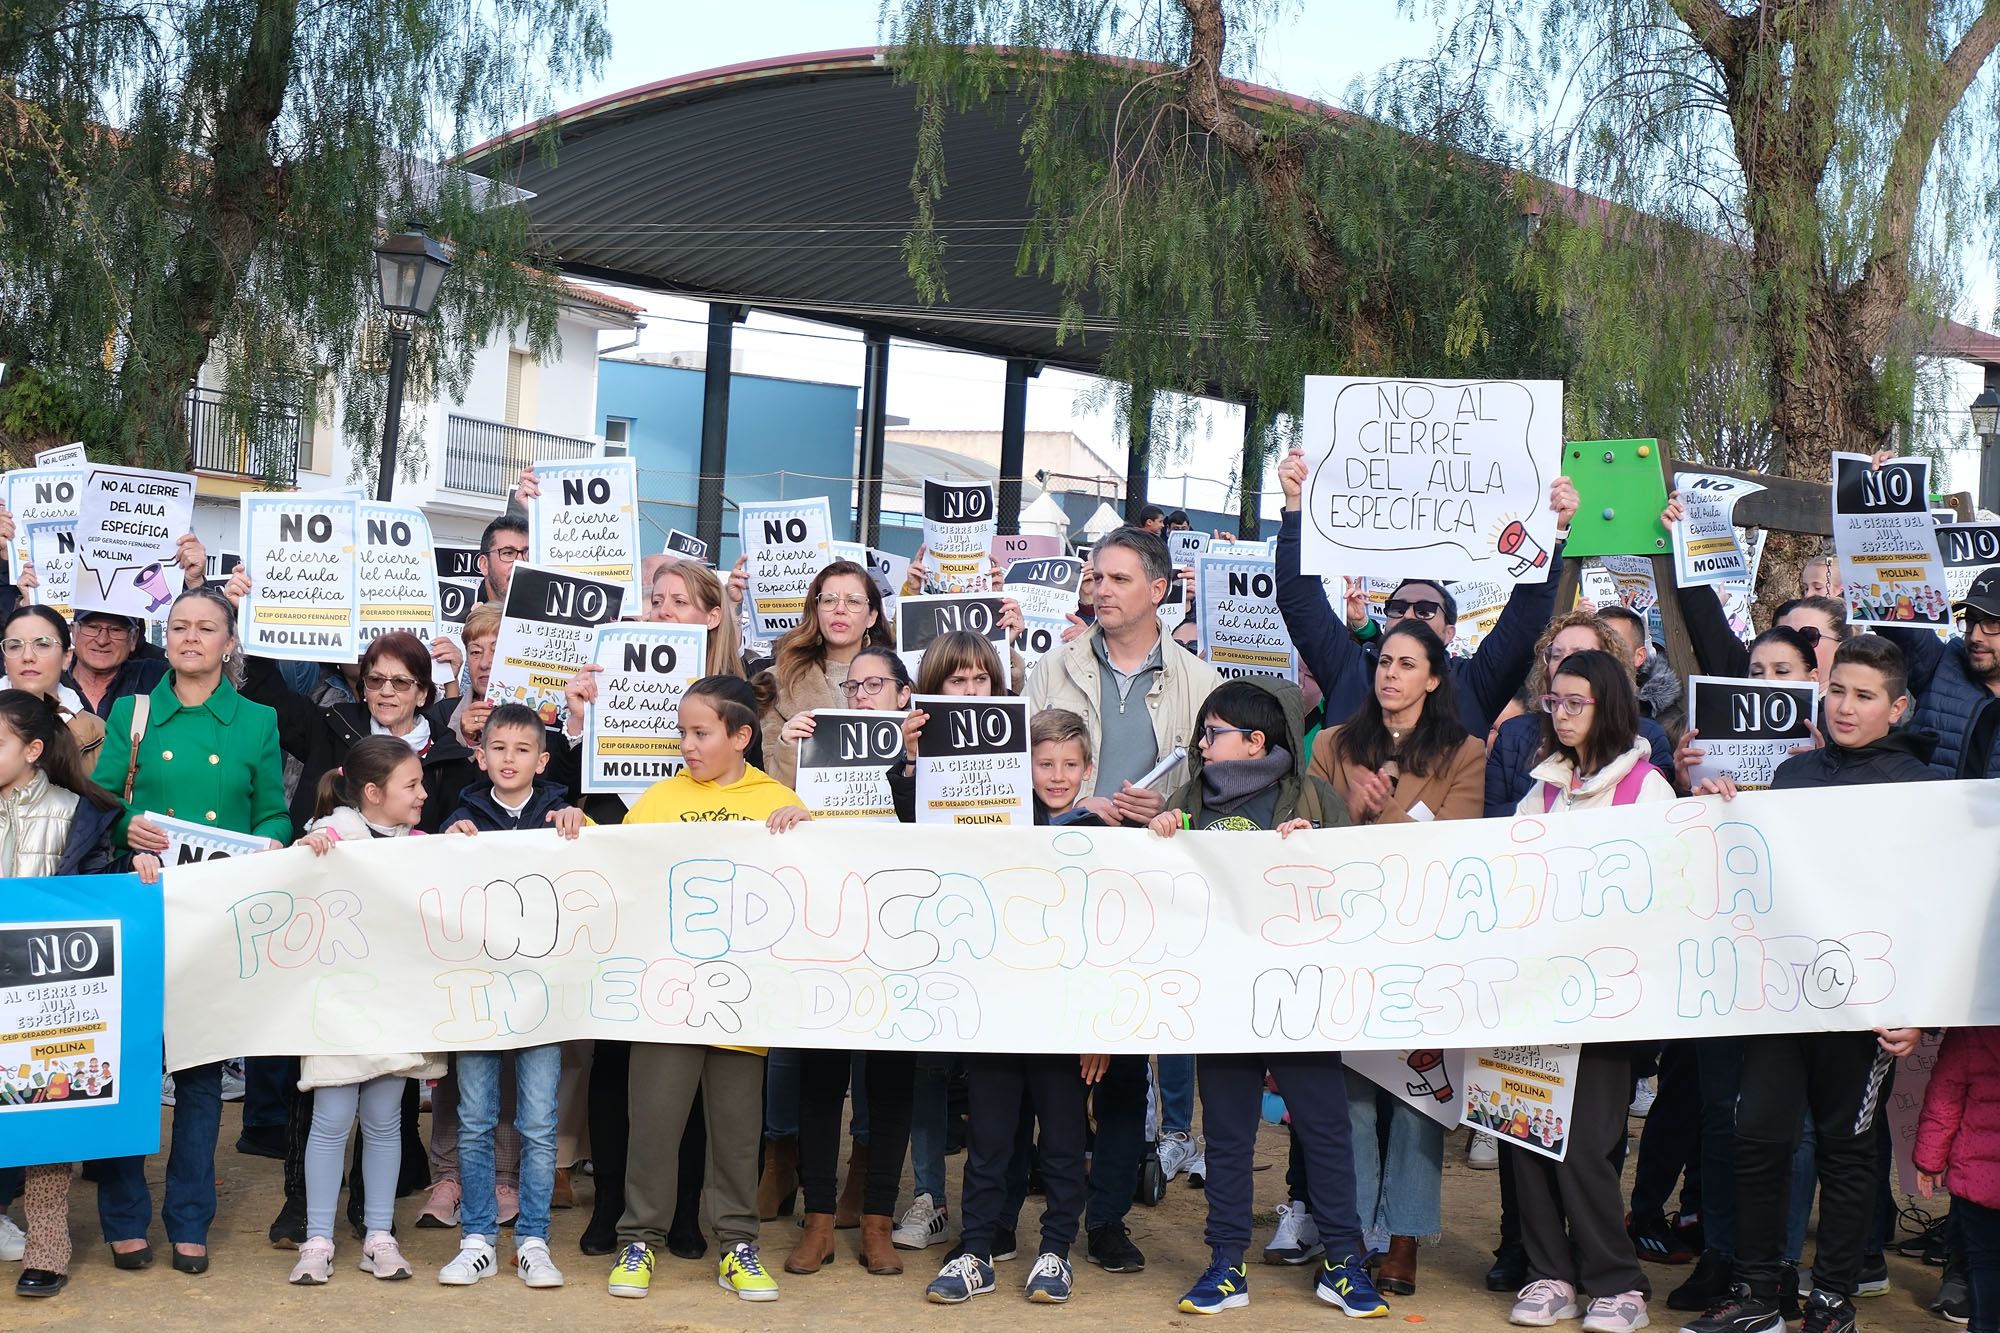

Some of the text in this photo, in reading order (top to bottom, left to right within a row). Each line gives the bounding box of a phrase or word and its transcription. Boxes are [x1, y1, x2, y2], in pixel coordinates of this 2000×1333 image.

[1378, 386, 1498, 422] NO AL
[1358, 420, 1472, 456] CIERRE
[52, 456, 58, 464] AL
[58, 452, 78, 463] CIERRE
[1346, 458, 1504, 494] DEL AULA
[101, 480, 180, 498] NO AL CIERRE
[562, 478, 610, 506] NO
[1692, 479, 1734, 491] NO
[1862, 466, 1912, 506] NO
[35, 482, 74, 504] NO
[1697, 494, 1724, 503] cierre
[110, 501, 165, 516] DEL AULA
[944, 489, 986, 518] NO
[22, 507, 78, 518] Al cierre
[553, 512, 620, 525] Al cierre
[1331, 492, 1476, 534] ESPECÍFICA
[101, 520, 169, 538] ESPECÍFICA
[280, 514, 332, 543] NO
[940, 524, 988, 535] CIERRE DEL
[1849, 516, 1924, 529] AL CIERRE DEL
[367, 519, 412, 546] NO
[553, 525, 620, 541] del Aula
[764, 518, 807, 544] NO
[1876, 529, 1902, 540] AULA
[102, 537, 128, 546] GERARDO
[128, 539, 160, 550] FERNÁNDEZ
[680, 537, 701, 554] NO
[947, 535, 970, 544] AULA
[1006, 540, 1028, 551] NO
[1182, 538, 1200, 550] NO
[1862, 540, 1924, 552] ESPECÍFICA
[1950, 530, 1999, 562] NO
[92, 549, 132, 562] MOLLINA
[266, 548, 340, 564] Al cierre
[378, 554, 420, 565] cierre
[550, 546, 626, 562] Específica
[757, 549, 816, 562] Al cierre
[1867, 554, 1894, 562] GERARDO
[46, 561, 62, 570] Al
[759, 562, 818, 578] del Aula
[942, 564, 975, 572] MOLLINA
[1694, 556, 1740, 572] MOLLINA
[49, 572, 70, 584] del
[266, 567, 338, 582] del Aula
[384, 568, 421, 581] Aula
[1028, 561, 1072, 584] NO
[1881, 570, 1919, 578] MOLLINA
[1229, 572, 1273, 598] NO
[1454, 584, 1466, 594] AL
[1600, 588, 1612, 596] DEL
[262, 586, 344, 604] Específica
[546, 580, 608, 622] NO
[1021, 586, 1052, 598] CIERRE
[1054, 592, 1070, 602] DEL
[1026, 594, 1048, 606] AULA
[396, 608, 432, 616] FERNÁNDEZ
[1160, 606, 1177, 615] DEL
[1218, 601, 1280, 614] Al cierre
[274, 612, 307, 620] GERARDO
[308, 612, 348, 621] FERNÁNDEZ
[934, 602, 992, 637] NO
[1218, 614, 1279, 630] del Aula
[259, 630, 343, 646] MOLLINA
[516, 624, 532, 635] AL
[536, 625, 580, 640] CIERRE
[544, 639, 576, 652] AULA
[1216, 632, 1284, 648] Específica
[623, 643, 678, 674] NO
[1228, 652, 1254, 660] GERARDO
[1254, 654, 1288, 662] FERNÁNDEZ
[524, 660, 556, 670] GERARDO
[609, 678, 684, 694] Al cierre
[609, 695, 679, 712] del Aula
[1732, 692, 1798, 732] NO
[949, 708, 1012, 748] NO
[840, 721, 902, 760] NO
[1708, 744, 1723, 755] AL
[1728, 744, 1774, 756] CIERRE
[930, 758, 1020, 773] AL CIERRE DEL
[1738, 757, 1771, 768] AULA
[814, 772, 830, 783] AL
[834, 770, 880, 782] CIERRE
[960, 772, 992, 784] AULA
[844, 782, 878, 794] AULA
[941, 783, 1014, 798] ESPECÍFICA
[946, 800, 976, 808] GERARDO
[977, 798, 1016, 806] FERNÁNDEZ
[957, 814, 1002, 824] MOLLINA
[226, 890, 370, 979] POR
[420, 870, 618, 962] UNA
[28, 932, 98, 976] NO
[4, 982, 108, 1004] AL CIERRE DEL
[1063, 969, 1200, 1042] POR
[1252, 947, 1642, 1042] NUESTROS
[40, 999, 75, 1014] AULA
[18, 1008, 100, 1029] ESPECÍFICA
[22, 1030, 56, 1038] GERARDO
[60, 1023, 102, 1034] FERNÁNDEZ
[36, 1042, 86, 1056] MOLLINA
[1493, 1048, 1560, 1073] ESPECÍFICA
[1480, 1058, 1560, 1084] CEIP GERARDO FERNÁNDEZ
[1505, 1080, 1546, 1098] MOLLINA
